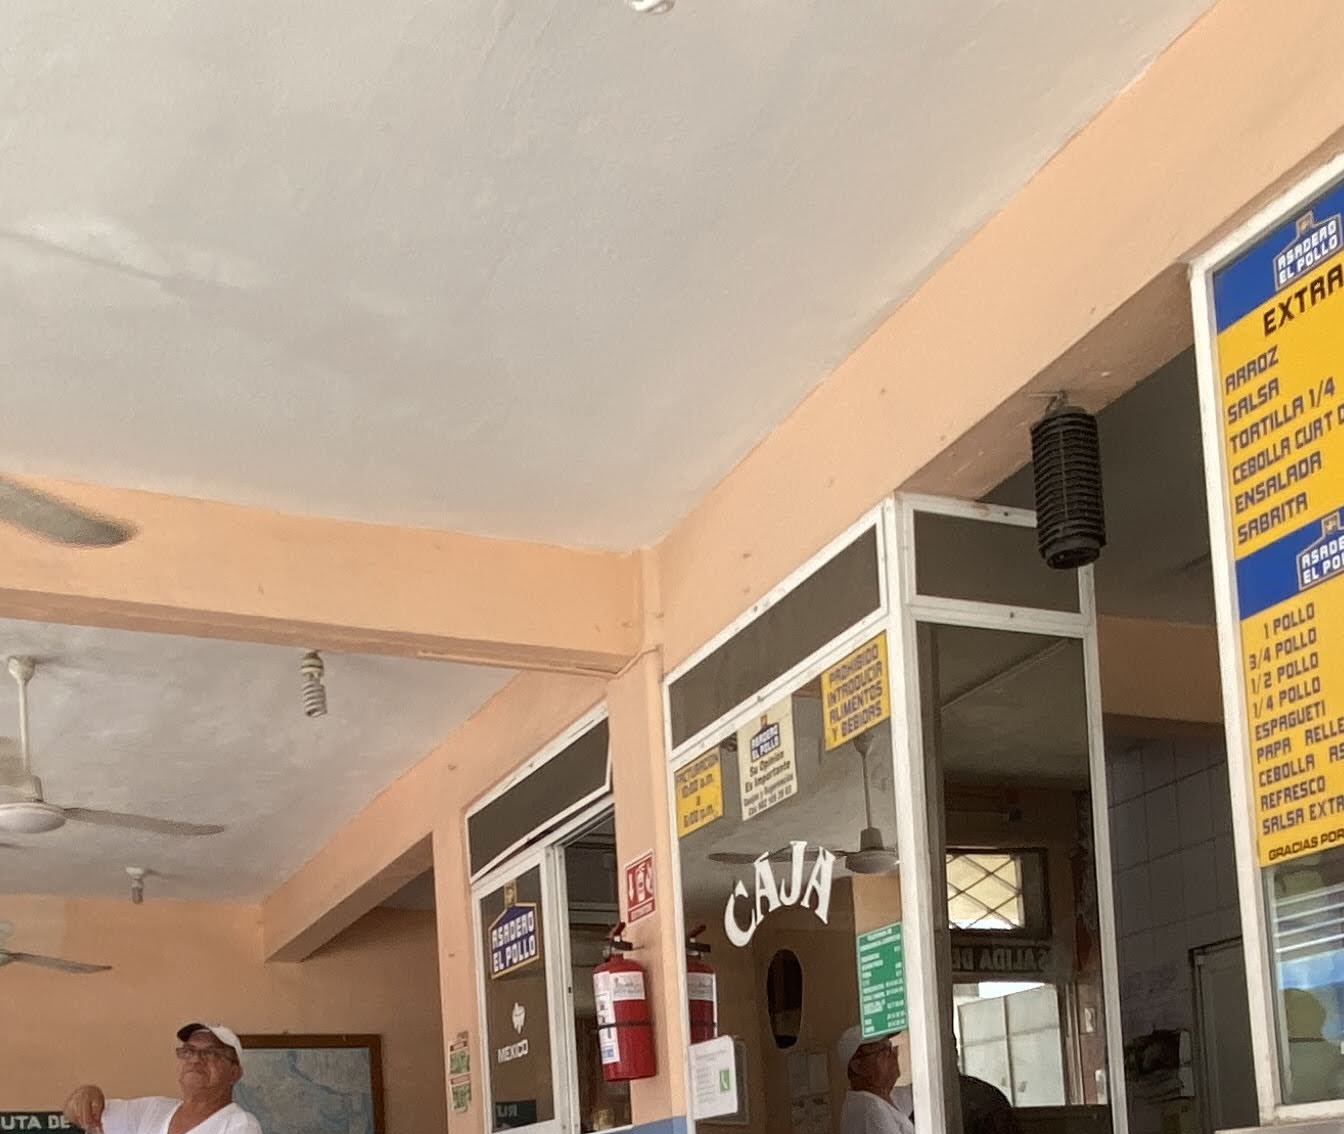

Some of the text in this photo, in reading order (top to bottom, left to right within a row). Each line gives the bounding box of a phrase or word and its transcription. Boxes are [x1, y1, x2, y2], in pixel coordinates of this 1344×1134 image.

[1277, 219, 1337, 271] ASADERO
[1279, 234, 1338, 285] EL POLLO
[1225, 344, 1279, 395] ARROZ
[1227, 377, 1280, 425] SALSA
[1229, 395, 1304, 454] TORTILLA
[1309, 376, 1335, 409] 1/4
[1232, 436, 1291, 486] CEBOLLA
[1235, 450, 1322, 515] ENSALADA
[1237, 491, 1308, 545] SABRITA
[1303, 566, 1320, 585] EL
[1273, 602, 1315, 636] POLLO
[1249, 646, 1271, 671] 3/4
[1275, 627, 1317, 660] POLLO
[1251, 671, 1272, 695] 1/2
[1277, 651, 1319, 684] POLLO
[1253, 694, 1273, 719] 1/4
[1279, 675, 1321, 708] POLLO
[1255, 699, 1326, 741] ESPAGUETI
[1256, 736, 1292, 765] PAPA
[1259, 753, 1316, 787] CEBOLLA
[1260, 775, 1326, 811] REFRESCO
[1262, 808, 1305, 836] SALSA
[1268, 835, 1319, 861] GRACIAS
[724, 840, 836, 947] CAJA
[492, 910, 534, 950] ASADERO
[493, 934, 536, 973] EL POLLO
